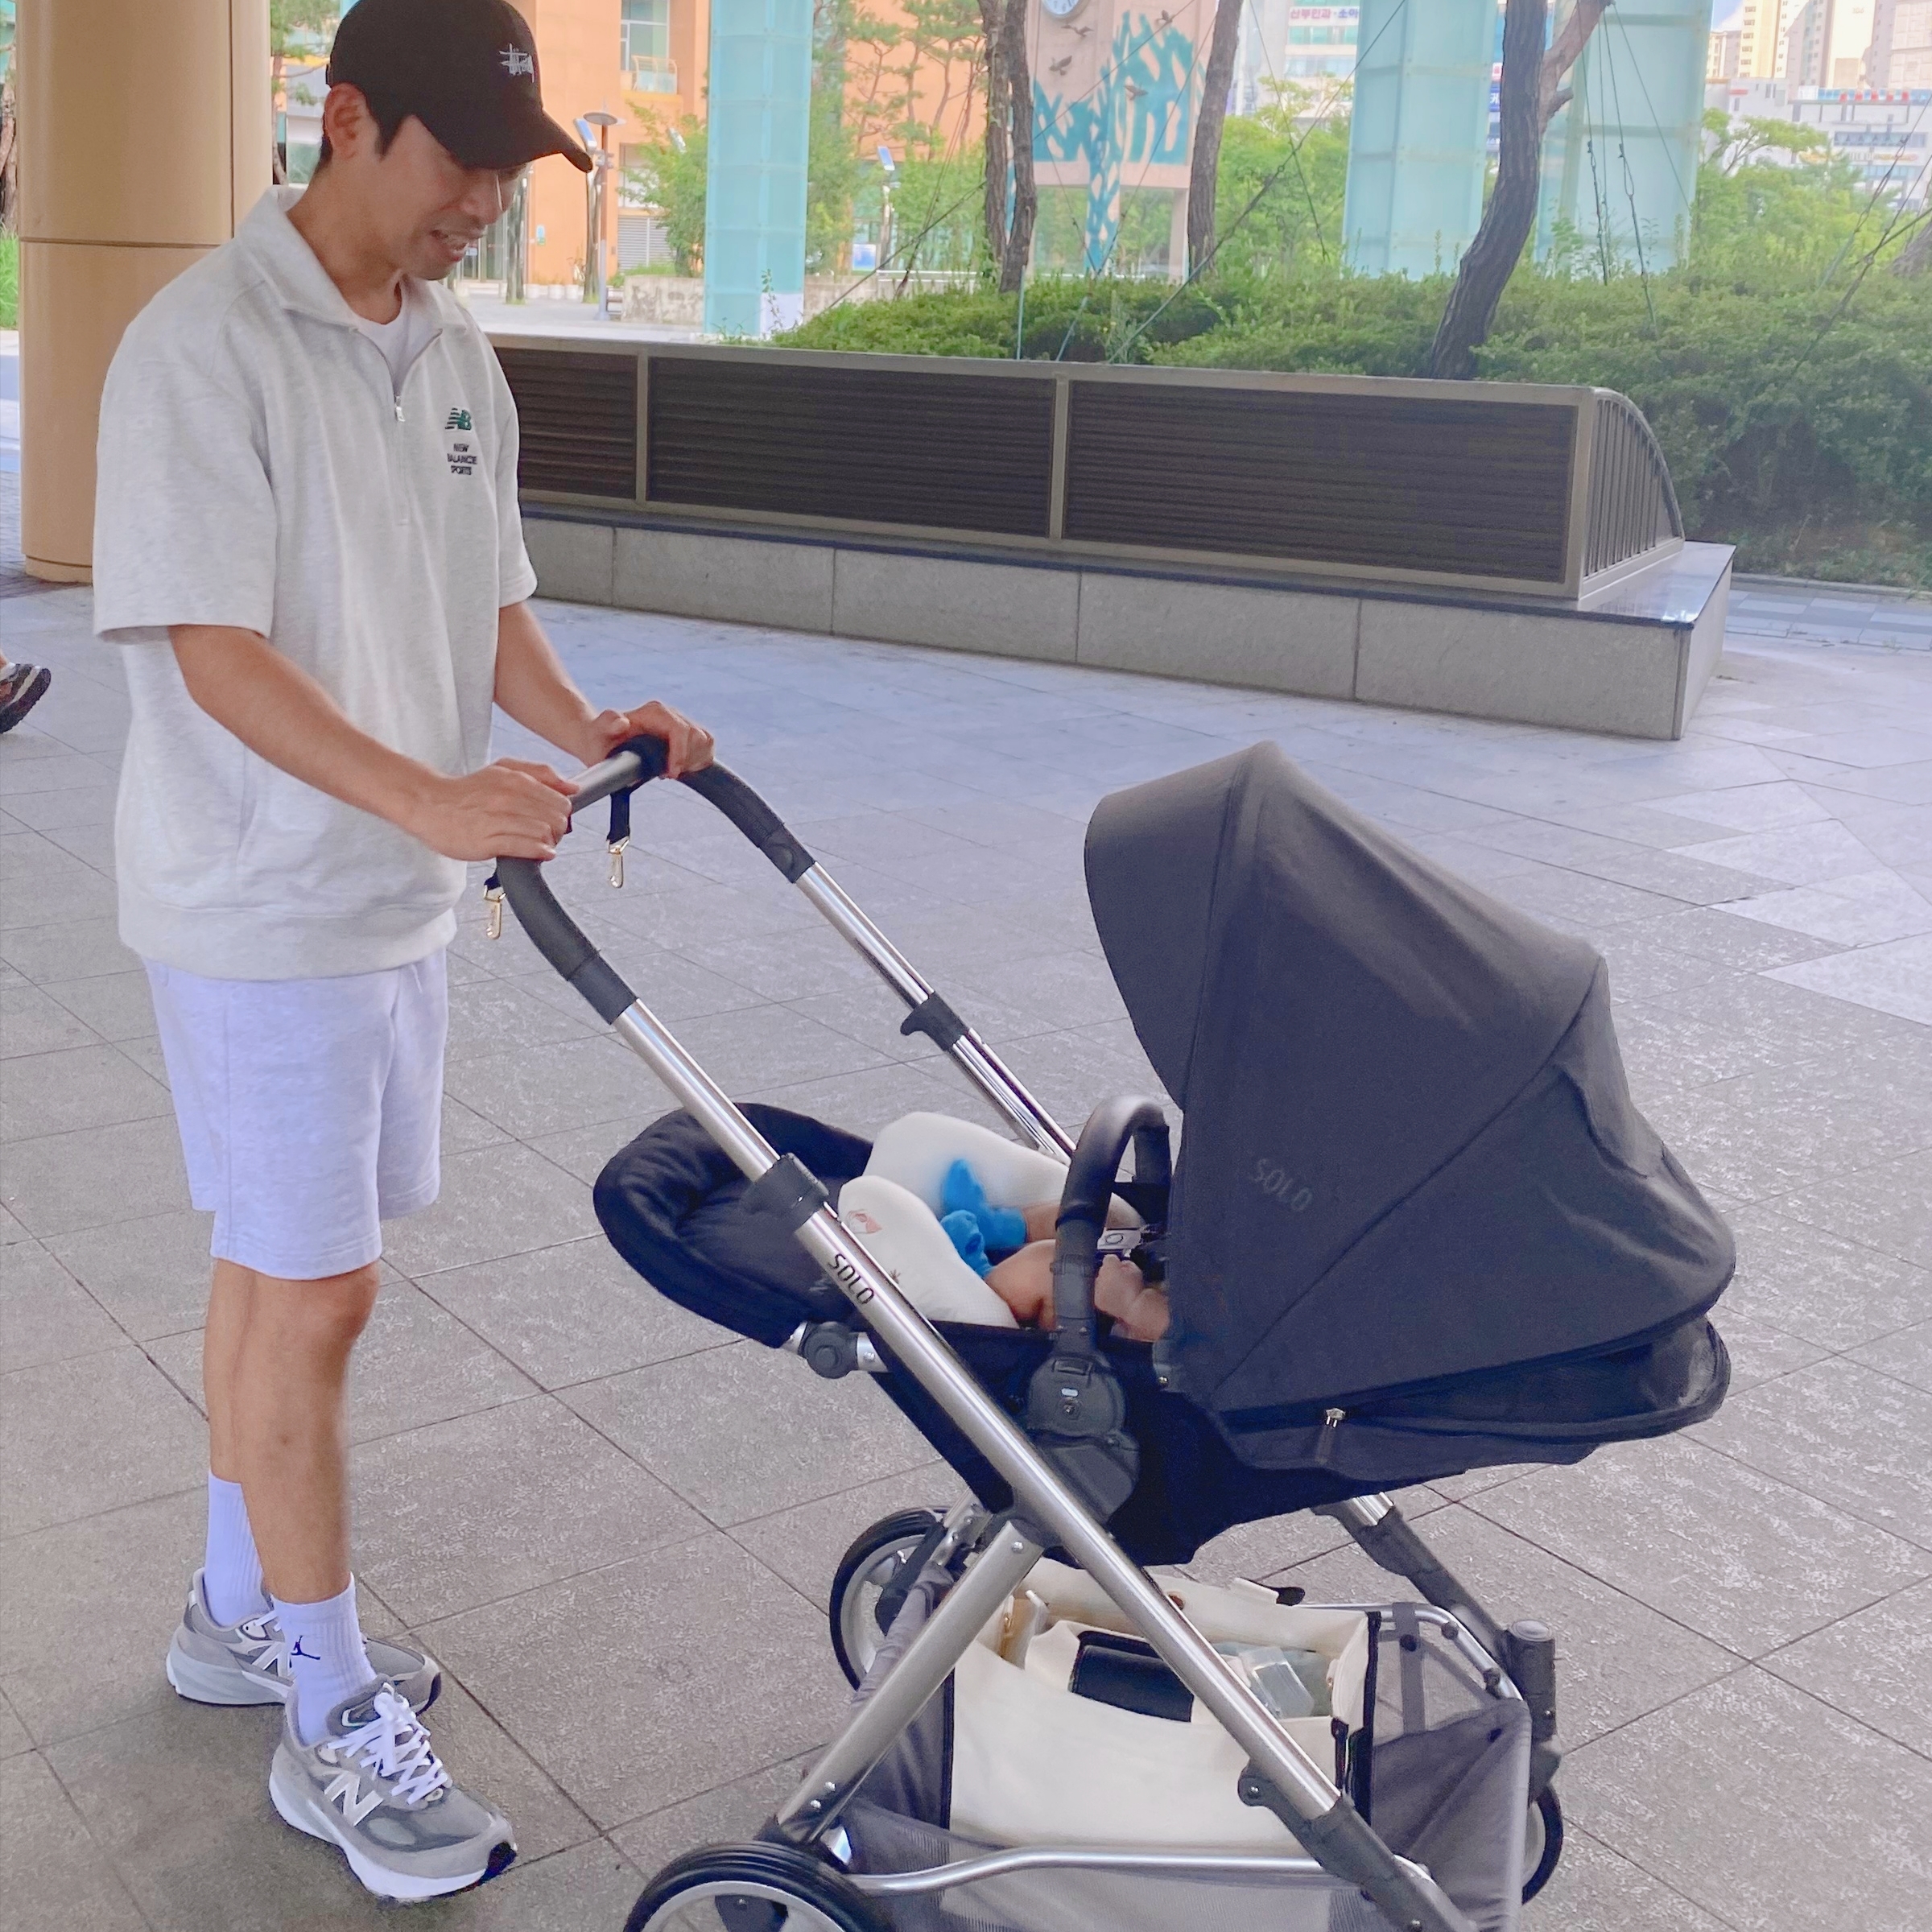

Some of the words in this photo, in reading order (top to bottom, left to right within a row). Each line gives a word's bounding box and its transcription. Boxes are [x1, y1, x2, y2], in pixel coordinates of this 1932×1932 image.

[453, 444, 469, 452] NEW
[1249, 1158, 1313, 1212] SOLO
[828, 1253, 875, 1305] SOLO
